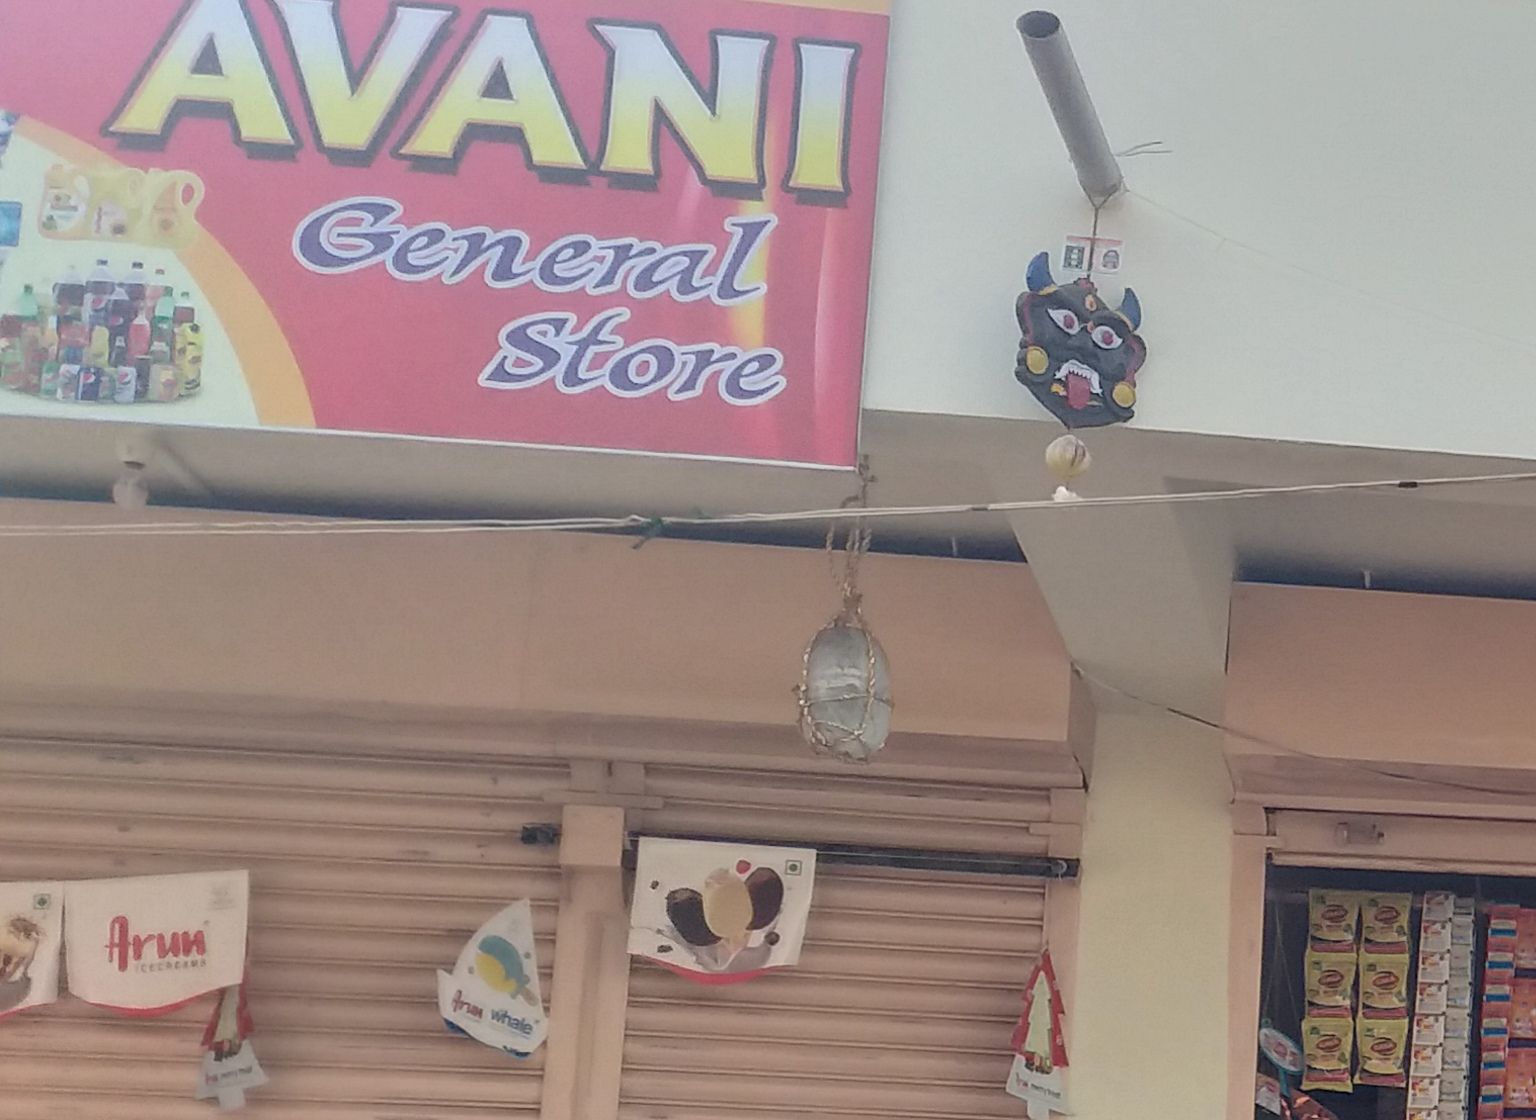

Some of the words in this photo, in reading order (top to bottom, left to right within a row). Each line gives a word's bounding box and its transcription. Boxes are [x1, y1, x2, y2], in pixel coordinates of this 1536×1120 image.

[102, 0, 860, 204] AVANI
[293, 195, 779, 306] General
[477, 307, 786, 407] Store
[104, 915, 206, 972] Arun
[491, 1009, 533, 1035] whale
